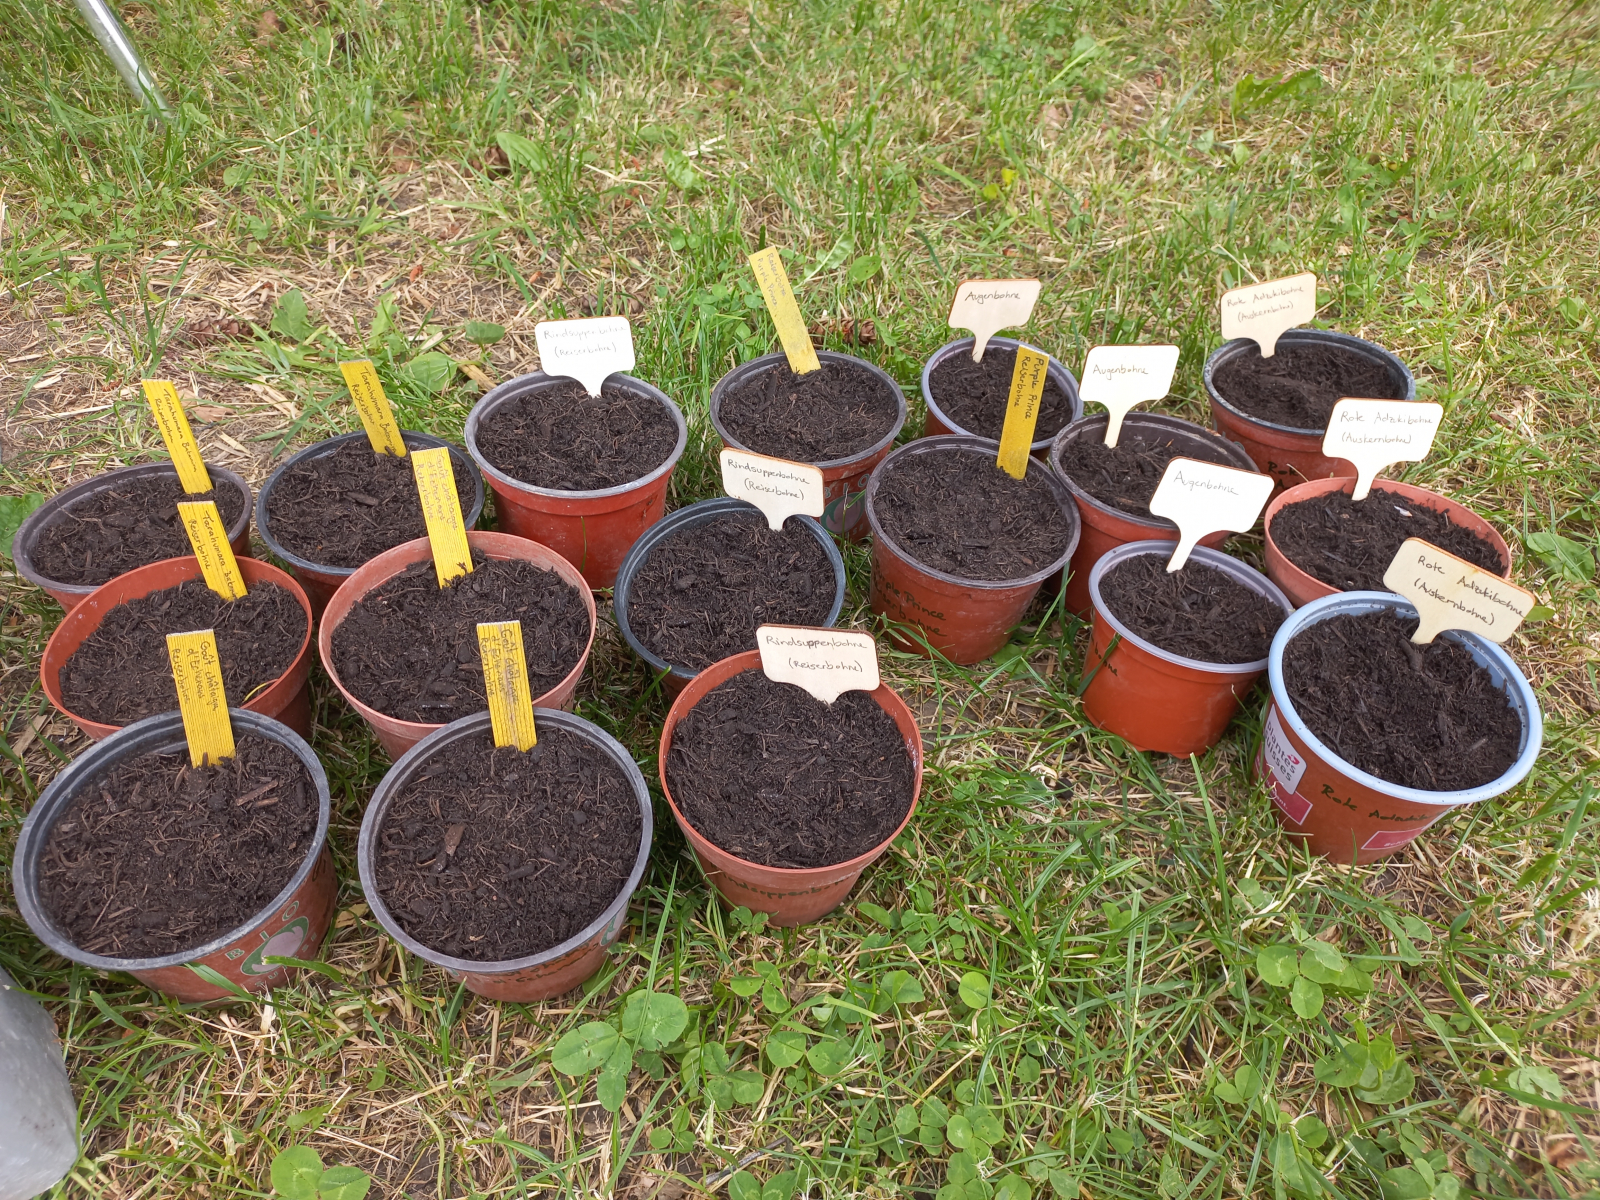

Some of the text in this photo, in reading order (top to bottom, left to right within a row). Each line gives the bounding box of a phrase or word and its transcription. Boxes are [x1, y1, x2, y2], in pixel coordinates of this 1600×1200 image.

[965, 290, 1021, 305] Augenbohne
[1092, 363, 1149, 381] Augenbohne
[1024, 357, 1045, 420] Purple Prince
[1340, 410, 1366, 424] Rote
[727, 457, 810, 484] Rindsuppenbohne
[1173, 470, 1239, 496] Augenbohne
[203, 510, 227, 566] Tarahumara
[1417, 555, 1446, 575] Rote
[766, 635, 868, 651] Rindsuppenbohne
[1267, 721, 1297, 774] plantes
[225, 900, 300, 961] BIO
